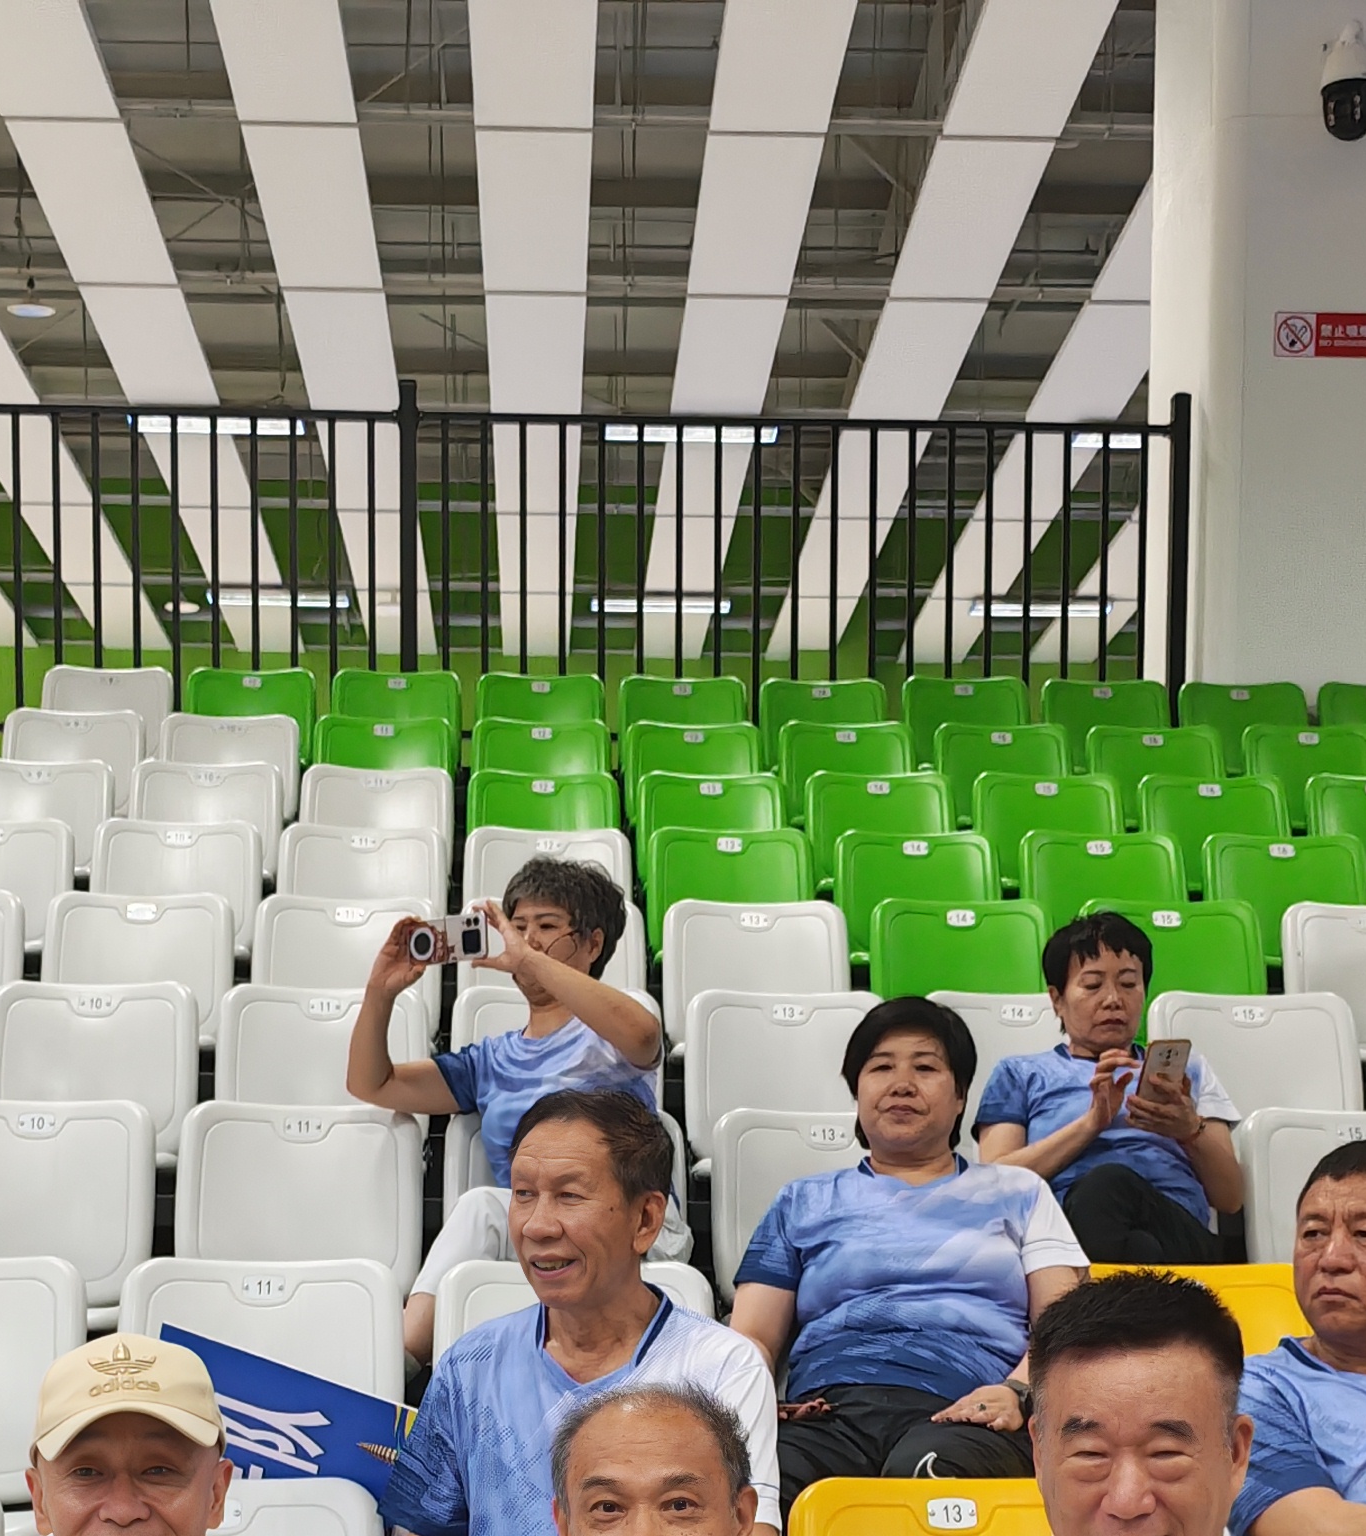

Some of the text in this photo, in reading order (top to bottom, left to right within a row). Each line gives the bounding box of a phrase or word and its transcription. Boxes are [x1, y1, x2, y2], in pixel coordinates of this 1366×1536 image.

[90, 998, 102, 1010] 10
[320, 1001, 330, 1012] 11
[783, 1007, 795, 1019] 13
[1012, 1008, 1024, 1019] 14
[31, 1117, 45, 1130] 10
[297, 1120, 310, 1133] 11
[822, 1128, 836, 1141] 13
[1349, 1127, 1363, 1140] 15
[257, 1280, 271, 1295] 11
[89, 1377, 160, 1397] adidas
[942, 1504, 962, 1523] 13
